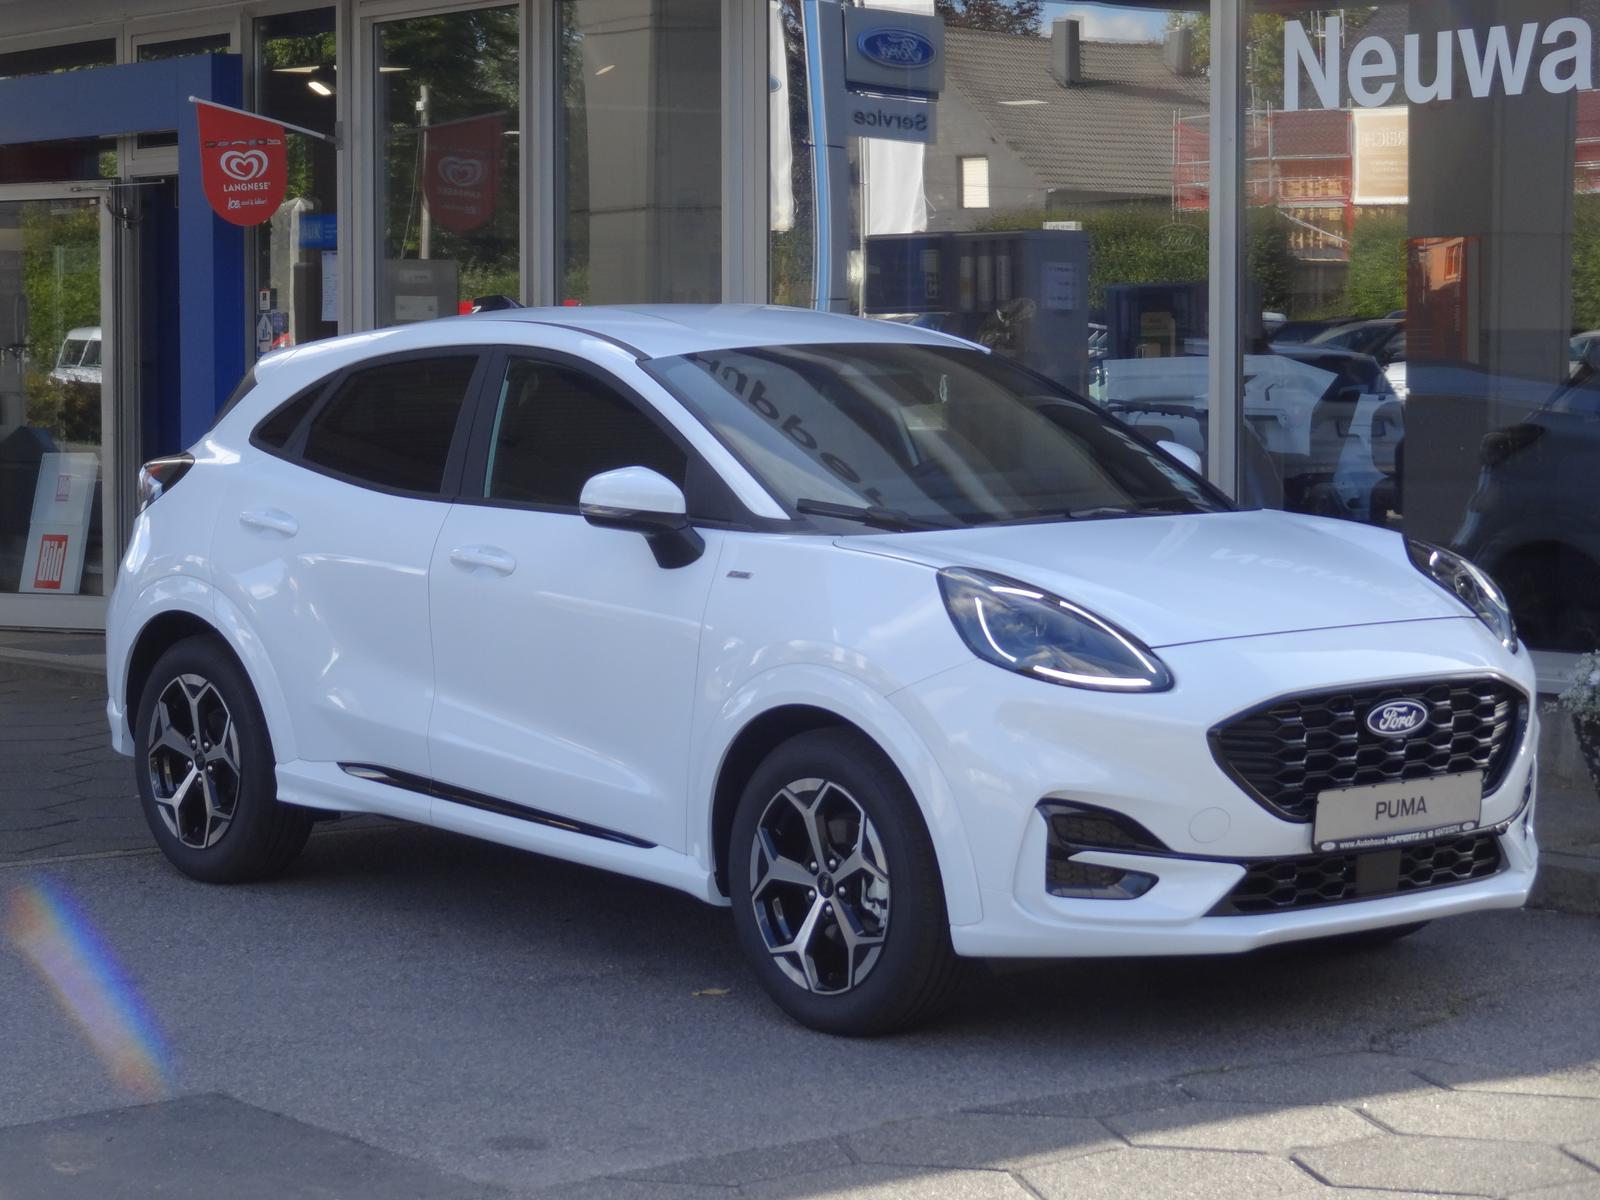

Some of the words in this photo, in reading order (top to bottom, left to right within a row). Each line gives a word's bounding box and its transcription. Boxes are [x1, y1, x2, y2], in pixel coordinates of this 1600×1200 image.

[1284, 16, 1593, 112] Neuwa
[37, 540, 66, 582] Bild
[1379, 706, 1417, 730] Ford
[1375, 795, 1428, 821] PUMA
